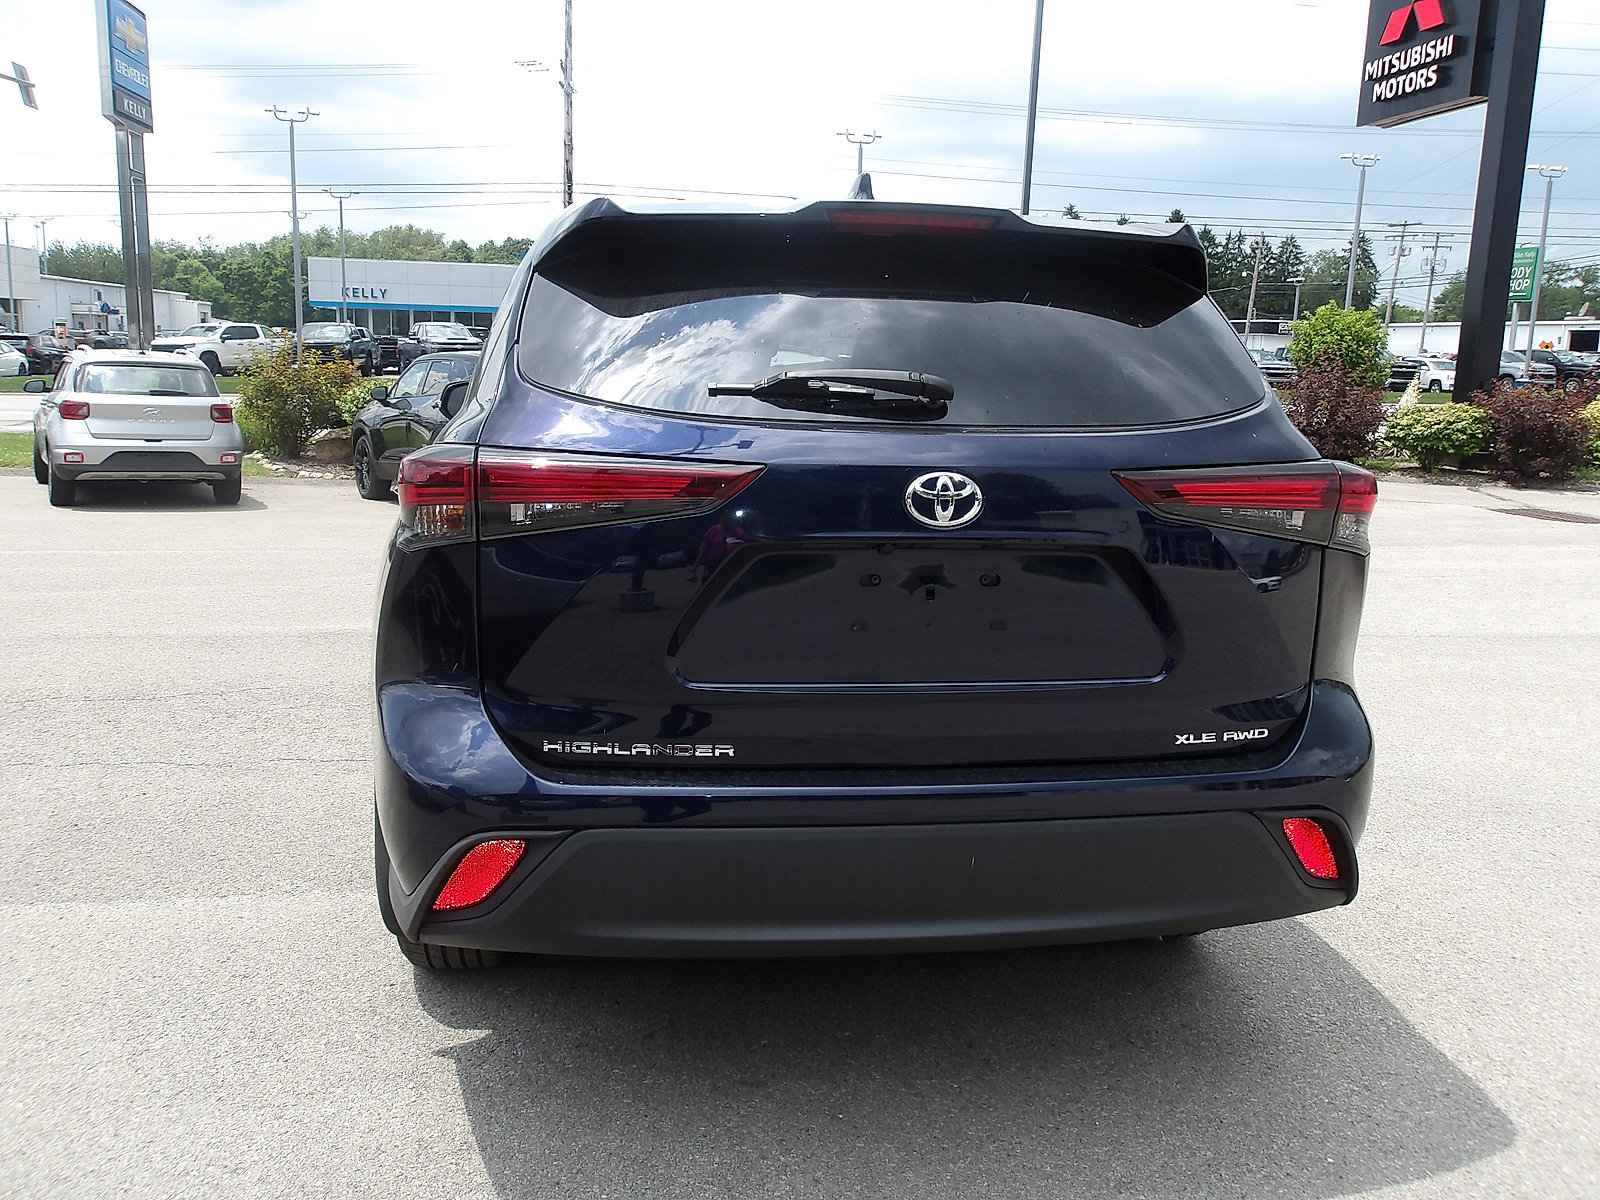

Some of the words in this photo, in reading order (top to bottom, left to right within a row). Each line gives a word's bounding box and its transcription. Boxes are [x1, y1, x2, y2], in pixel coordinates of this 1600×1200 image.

[1364, 33, 1455, 81] MITSUBISHI
[1372, 64, 1439, 103] MOTORS
[123, 98, 146, 119] KELLY
[1511, 266, 1533, 278] ODY
[341, 287, 387, 299] KELLY
[1510, 279, 1530, 290] HOP
[1174, 732, 1217, 745] XLE
[1222, 728, 1269, 742] AWD
[542, 739, 735, 757] HIGHLANDER
